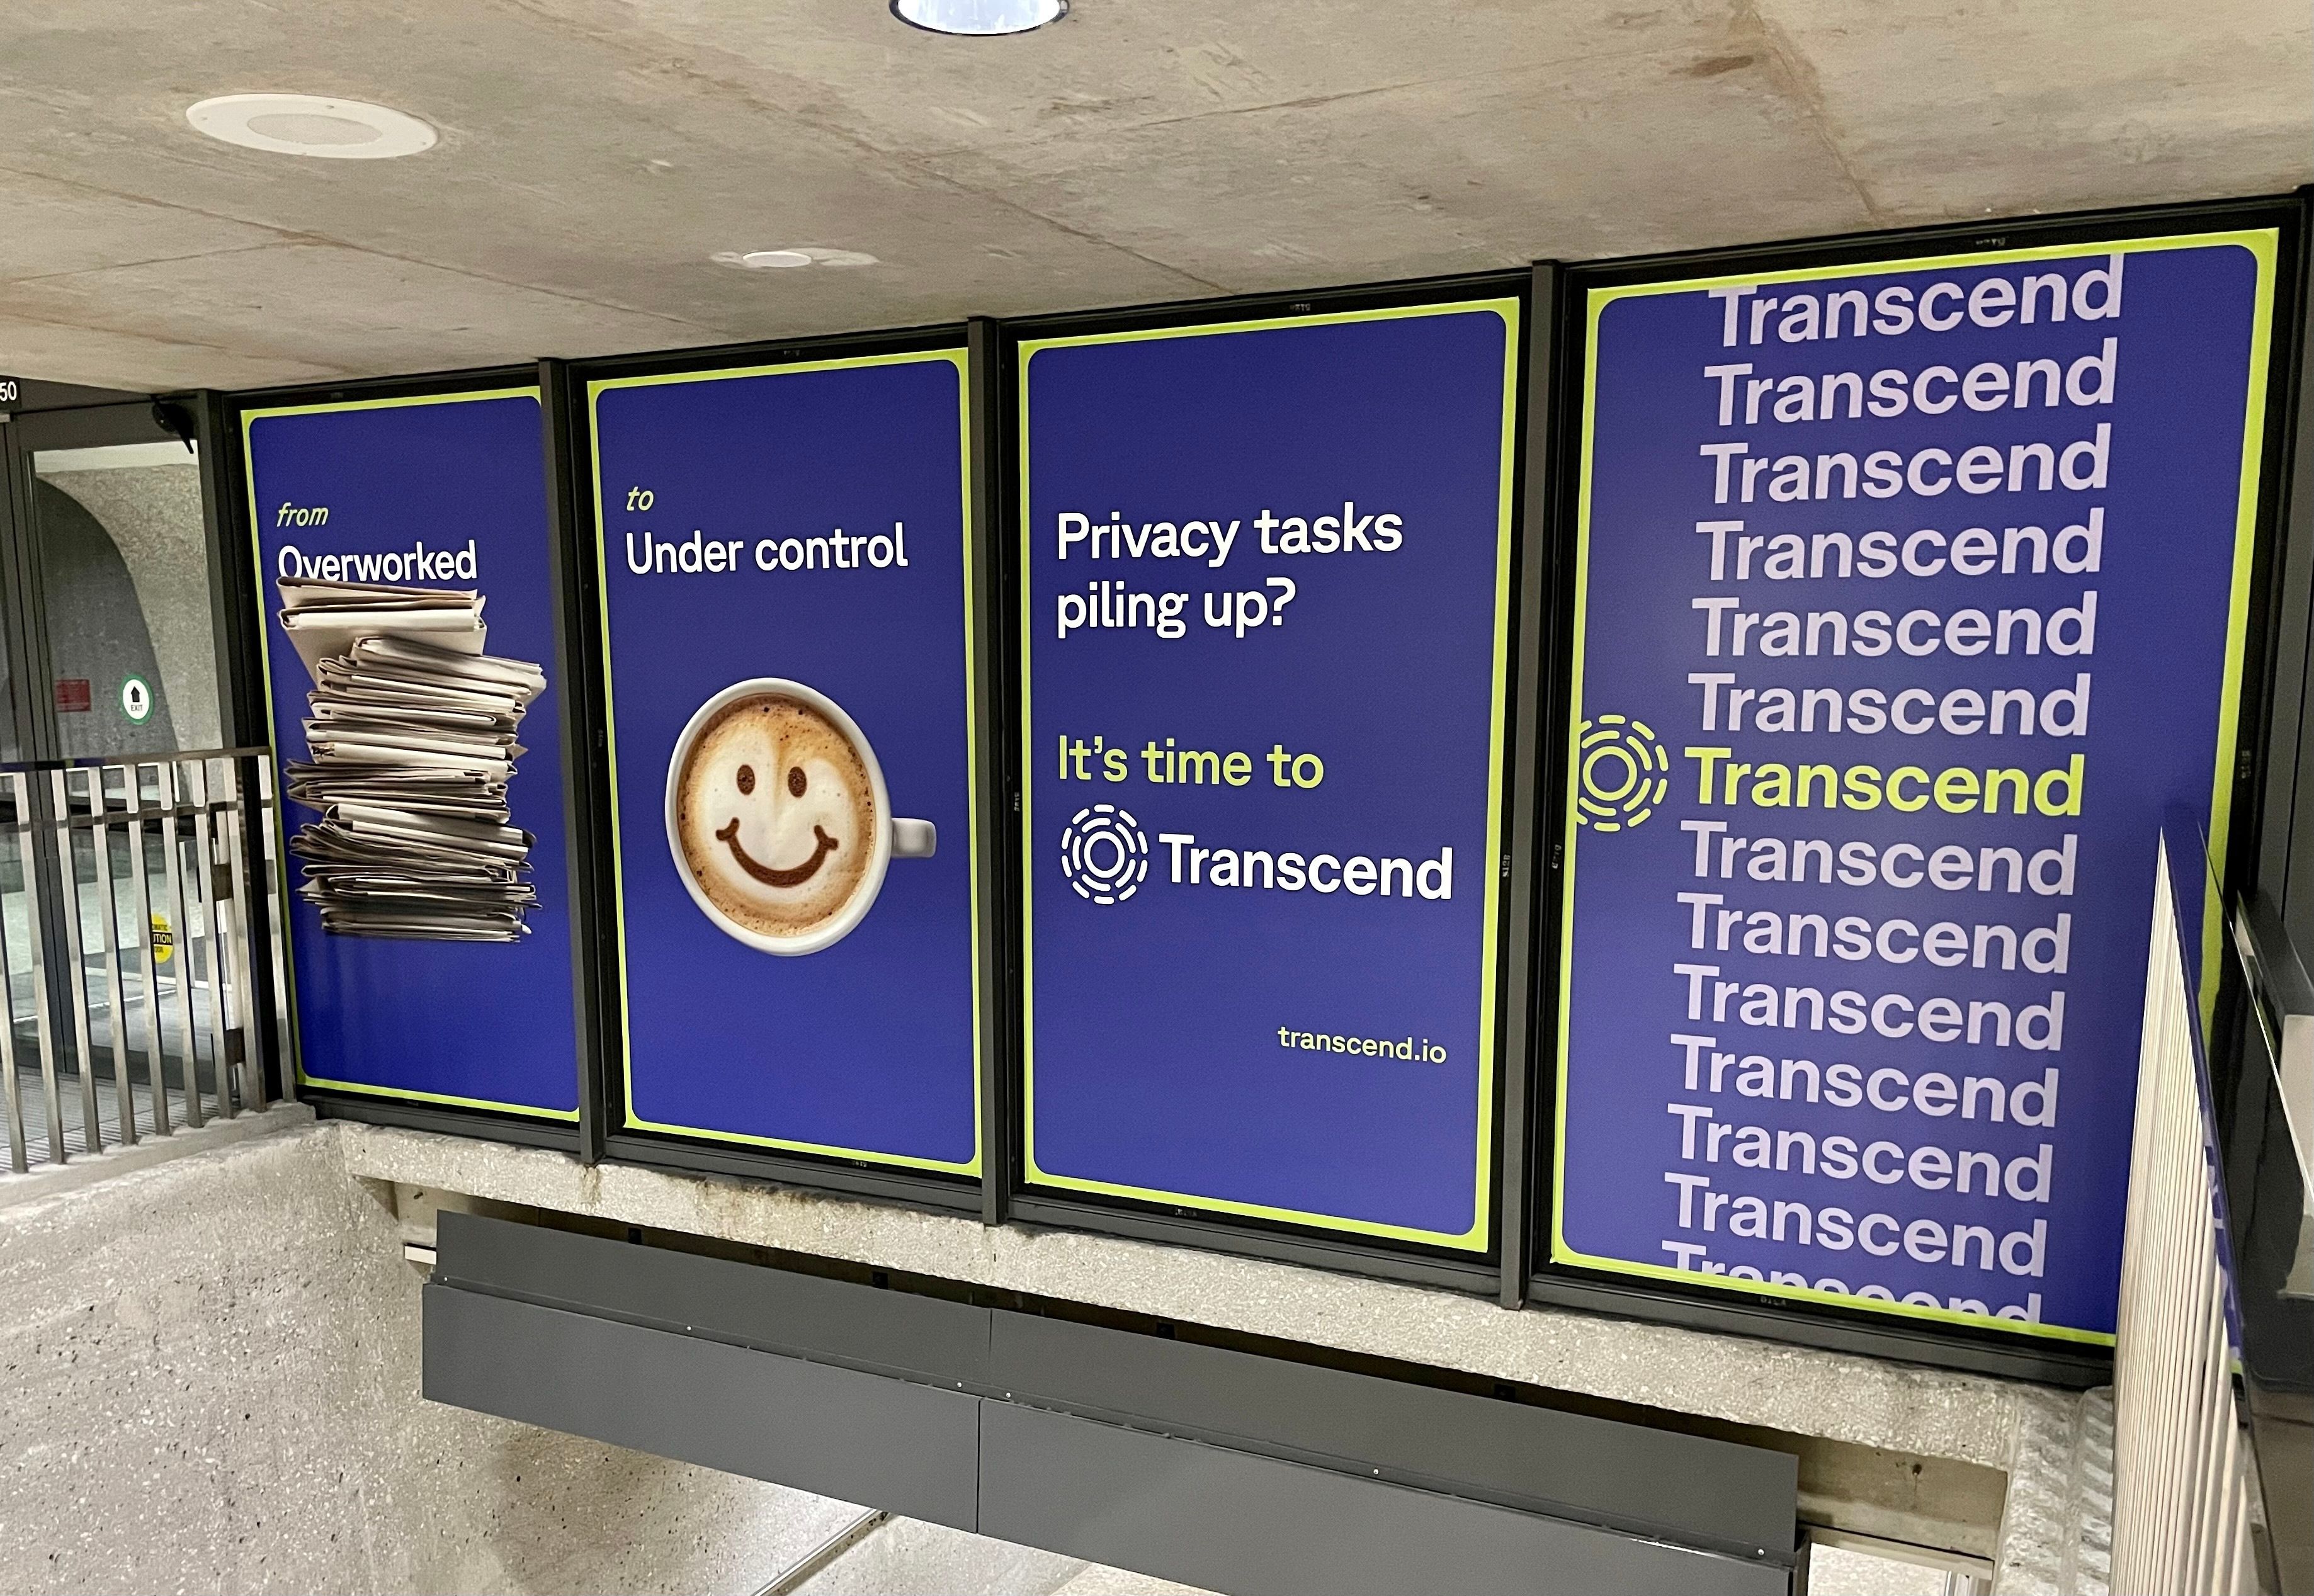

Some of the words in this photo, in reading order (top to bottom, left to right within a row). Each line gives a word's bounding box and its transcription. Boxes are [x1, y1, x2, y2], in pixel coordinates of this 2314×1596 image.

[1708, 253, 2124, 347] Transcend
[1704, 337, 2117, 426] Transcend
[1700, 423, 2111, 503] Transcend
[277, 502, 329, 528] from
[627, 486, 654, 511] to
[278, 539, 477, 582] Overworked
[626, 529, 744, 575] Under
[755, 521, 909, 572] control
[1058, 511, 1241, 568] Privacy
[1253, 501, 1403, 555] tasks
[1696, 507, 2104, 580] Transcend
[1058, 580, 1189, 639] piling
[1204, 577, 1296, 638] up?
[1692, 591, 2097, 655] Transcend
[1688, 673, 2090, 736] Transcend
[1059, 735, 1128, 783] It’s
[1140, 738, 1252, 786] time
[1266, 744, 1324, 789] to
[1685, 747, 2084, 816] Transcend
[1159, 833, 1453, 900] Transcend
[1681, 820, 2077, 895] Transcend
[1677, 892, 2070, 973] Transcend
[1674, 964, 2065, 1050] Transcend
[1277, 1026, 1447, 1063] transcend.io
[1670, 1034, 2058, 1127] Transcend
[1668, 1103, 2053, 1202] Transcend
[1665, 1172, 2046, 1276] Transcend
